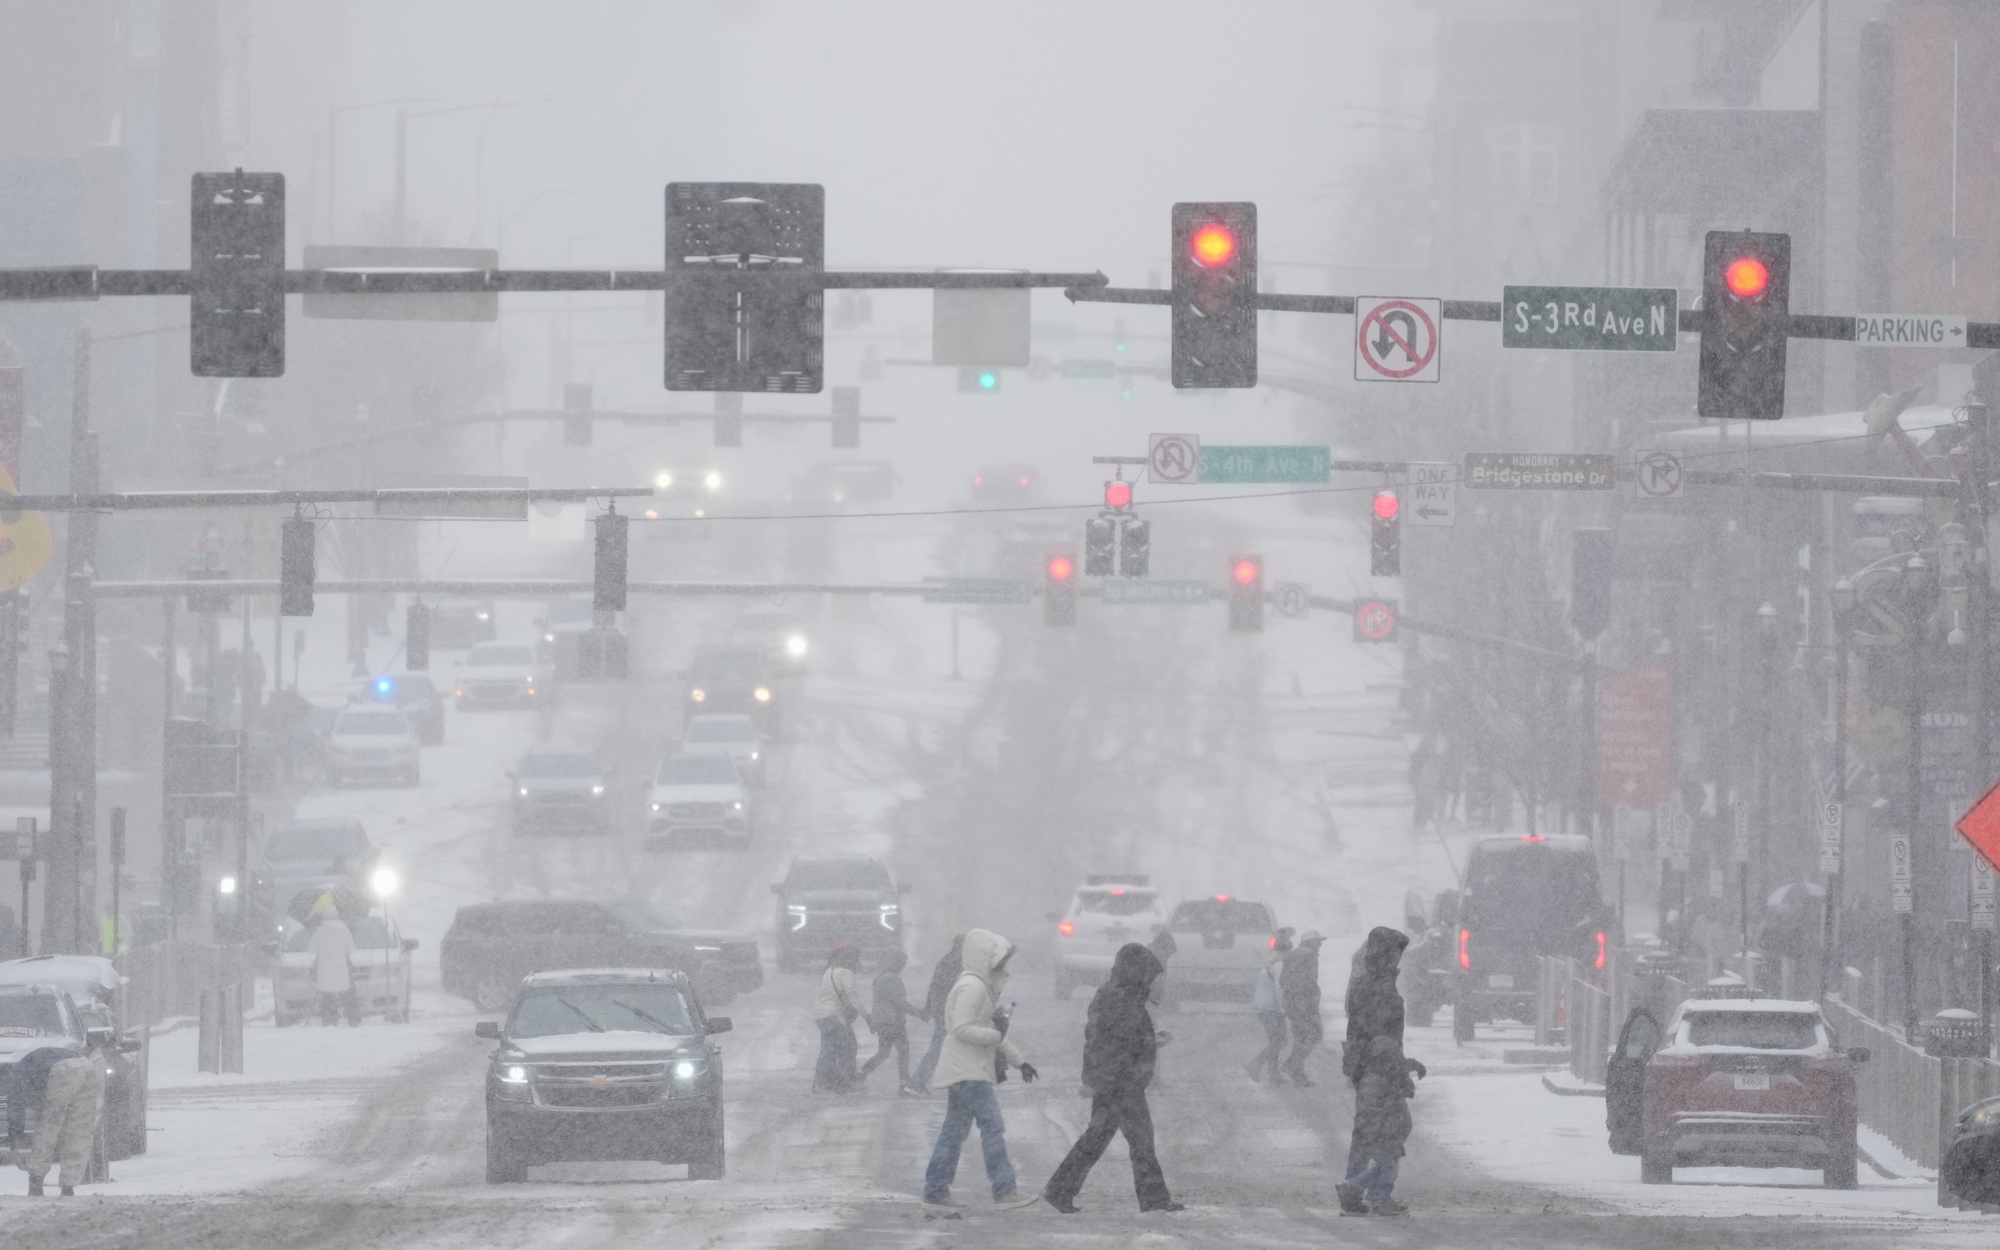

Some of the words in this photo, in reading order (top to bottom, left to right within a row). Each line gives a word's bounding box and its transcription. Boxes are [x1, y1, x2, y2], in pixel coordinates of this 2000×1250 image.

[1601, 310, 1645, 335] Ave
[1650, 305, 1665, 336] N
[1856, 317, 1945, 343] PARKING
[1512, 455, 1560, 467] HONORARY
[1416, 468, 1450, 483] ONE
[1472, 466, 1585, 487] Bridgestone
[1588, 472, 1607, 485] Dr
[1415, 485, 1450, 500] WAY
